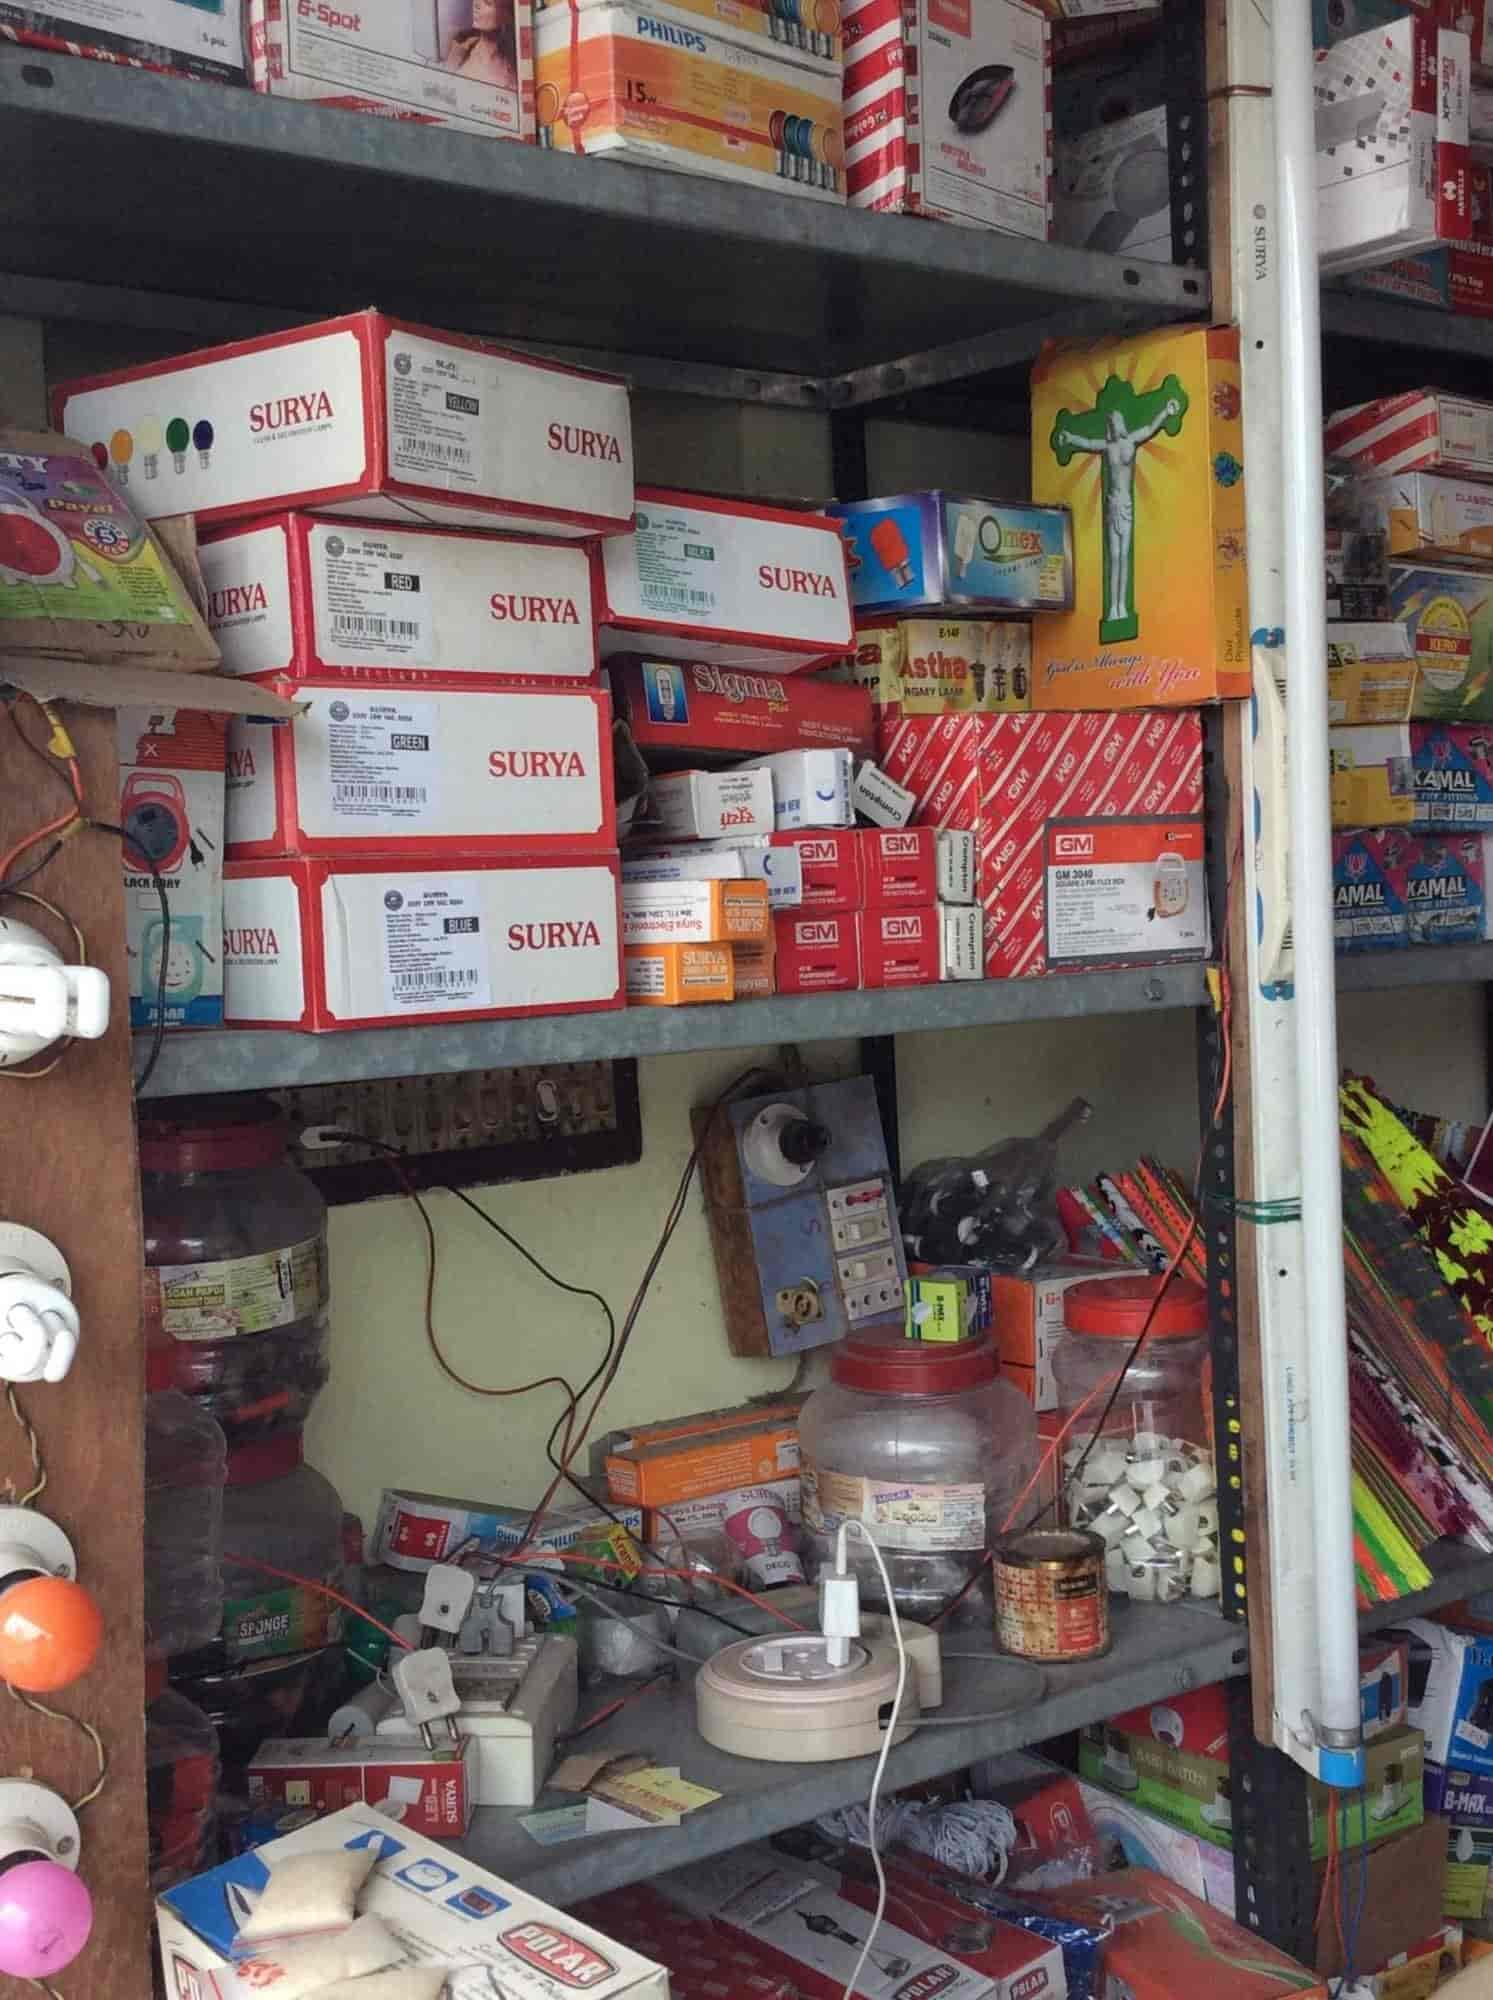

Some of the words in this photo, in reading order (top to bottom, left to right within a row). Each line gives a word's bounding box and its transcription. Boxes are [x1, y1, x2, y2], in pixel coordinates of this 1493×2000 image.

[637, 16, 706, 53] PHILIPS
[1254, 226, 1267, 281] SURYA
[250, 391, 334, 433] SURYA
[548, 423, 622, 463] SURYA
[391, 574, 413, 590] RED
[759, 565, 837, 599] SURYA
[490, 593, 580, 624] SURYA
[897, 650, 969, 680] Astha
[692, 664, 789, 703] Sigma
[393, 735, 425, 749] GREEN
[488, 751, 585, 778] SURYA
[1413, 768, 1475, 788] KAMAL
[858, 785, 902, 822] Crompton
[799, 843, 836, 859] GM
[885, 835, 918, 851] GM
[1059, 837, 1092, 852] GM
[962, 836, 970, 893] Crompton
[1407, 876, 1466, 897] KAMAL
[448, 918, 473, 933] BLUE
[507, 921, 601, 951] SURYA
[674, 918, 703, 932] Surya
[800, 923, 837, 940] GM
[885, 918, 920, 936] GM
[223, 927, 280, 957] SURYA
[969, 912, 977, 971] Crompton
[239, 1613, 289, 1637] SPONGE
[445, 1779, 458, 1824] SURYA
[1444, 1790, 1488, 1815] B-MAX
[509, 1925, 601, 1982] POLAR
[1011, 1970, 1047, 2000] POLAR
